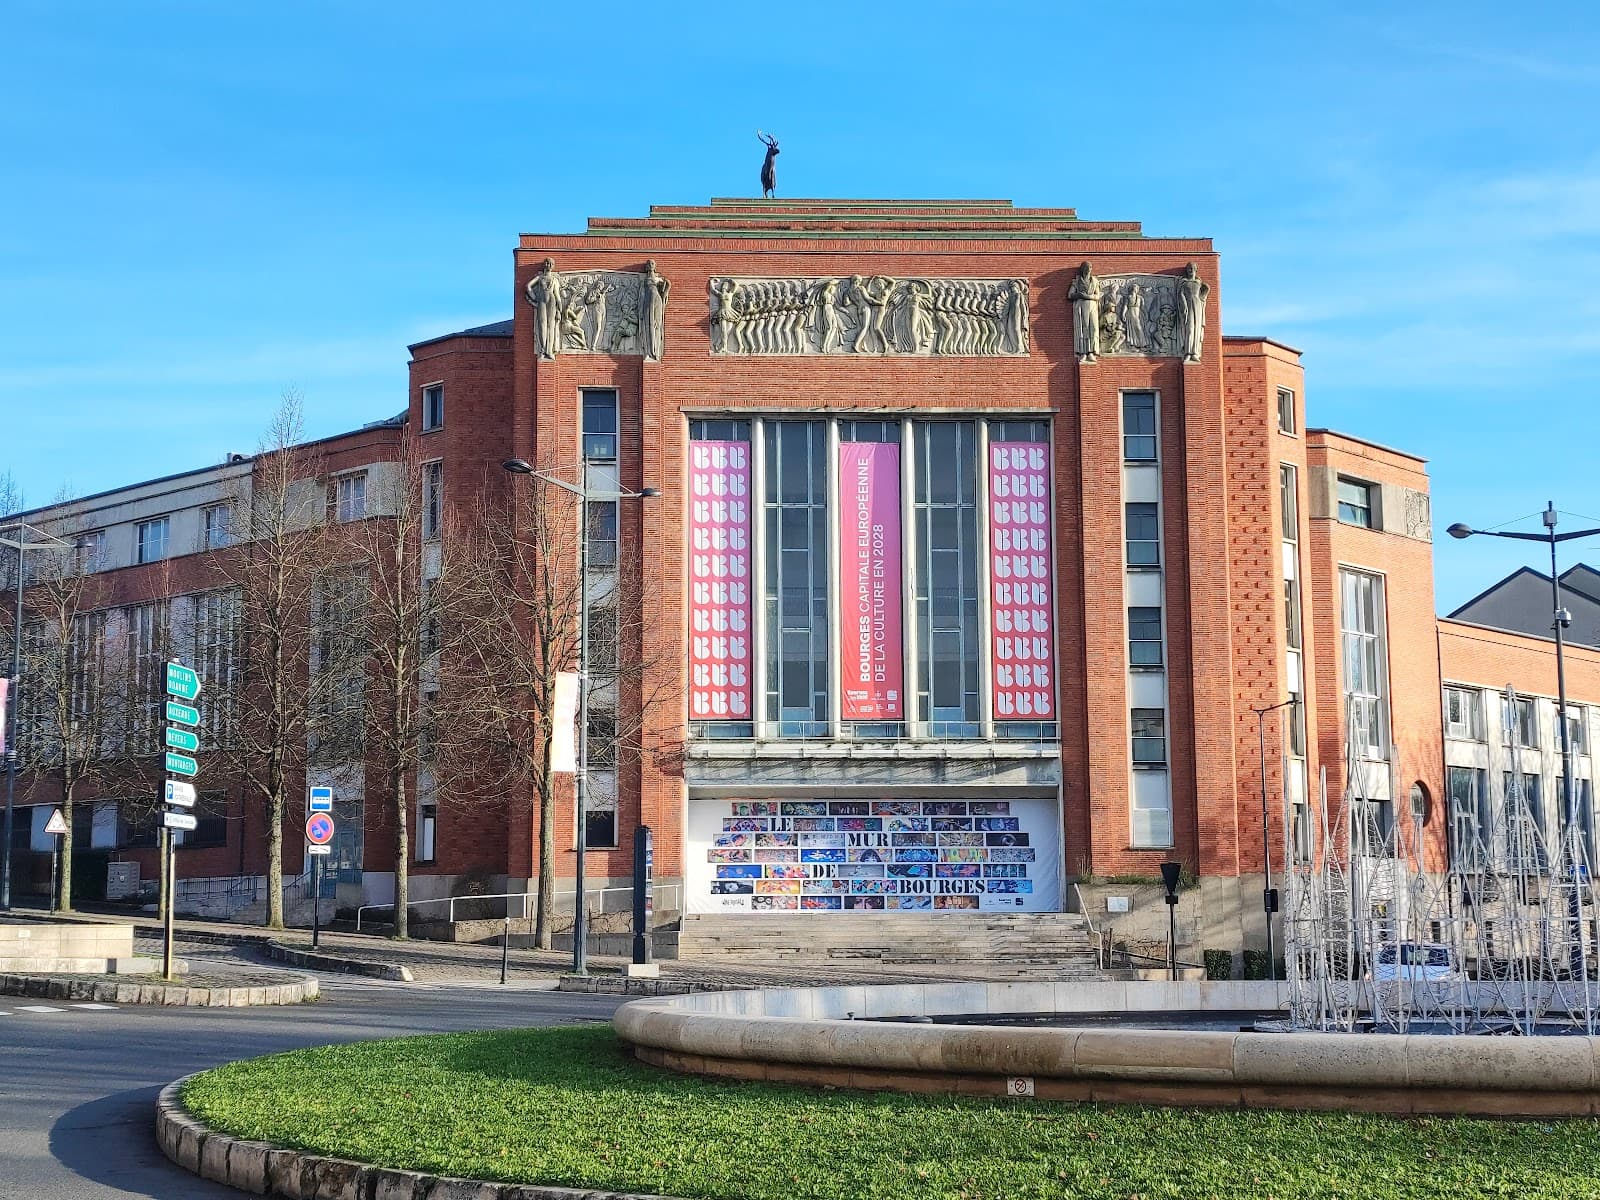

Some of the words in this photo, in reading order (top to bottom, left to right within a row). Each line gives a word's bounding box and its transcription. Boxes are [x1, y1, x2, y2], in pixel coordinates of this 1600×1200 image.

[856, 458, 869, 547] EUROPÉENNE
[873, 524, 883, 556] 2028
[874, 560, 884, 578] EN
[859, 550, 869, 612] CAPITALE
[874, 581, 884, 640] CULTURE
[860, 615, 870, 682] BOURGES
[874, 643, 885, 661] LA
[875, 663, 885, 682] DE
[771, 818, 791, 831] LE
[848, 833, 888, 847] MUR
[813, 864, 836, 878] DE
[900, 879, 985, 894] BOURGES
